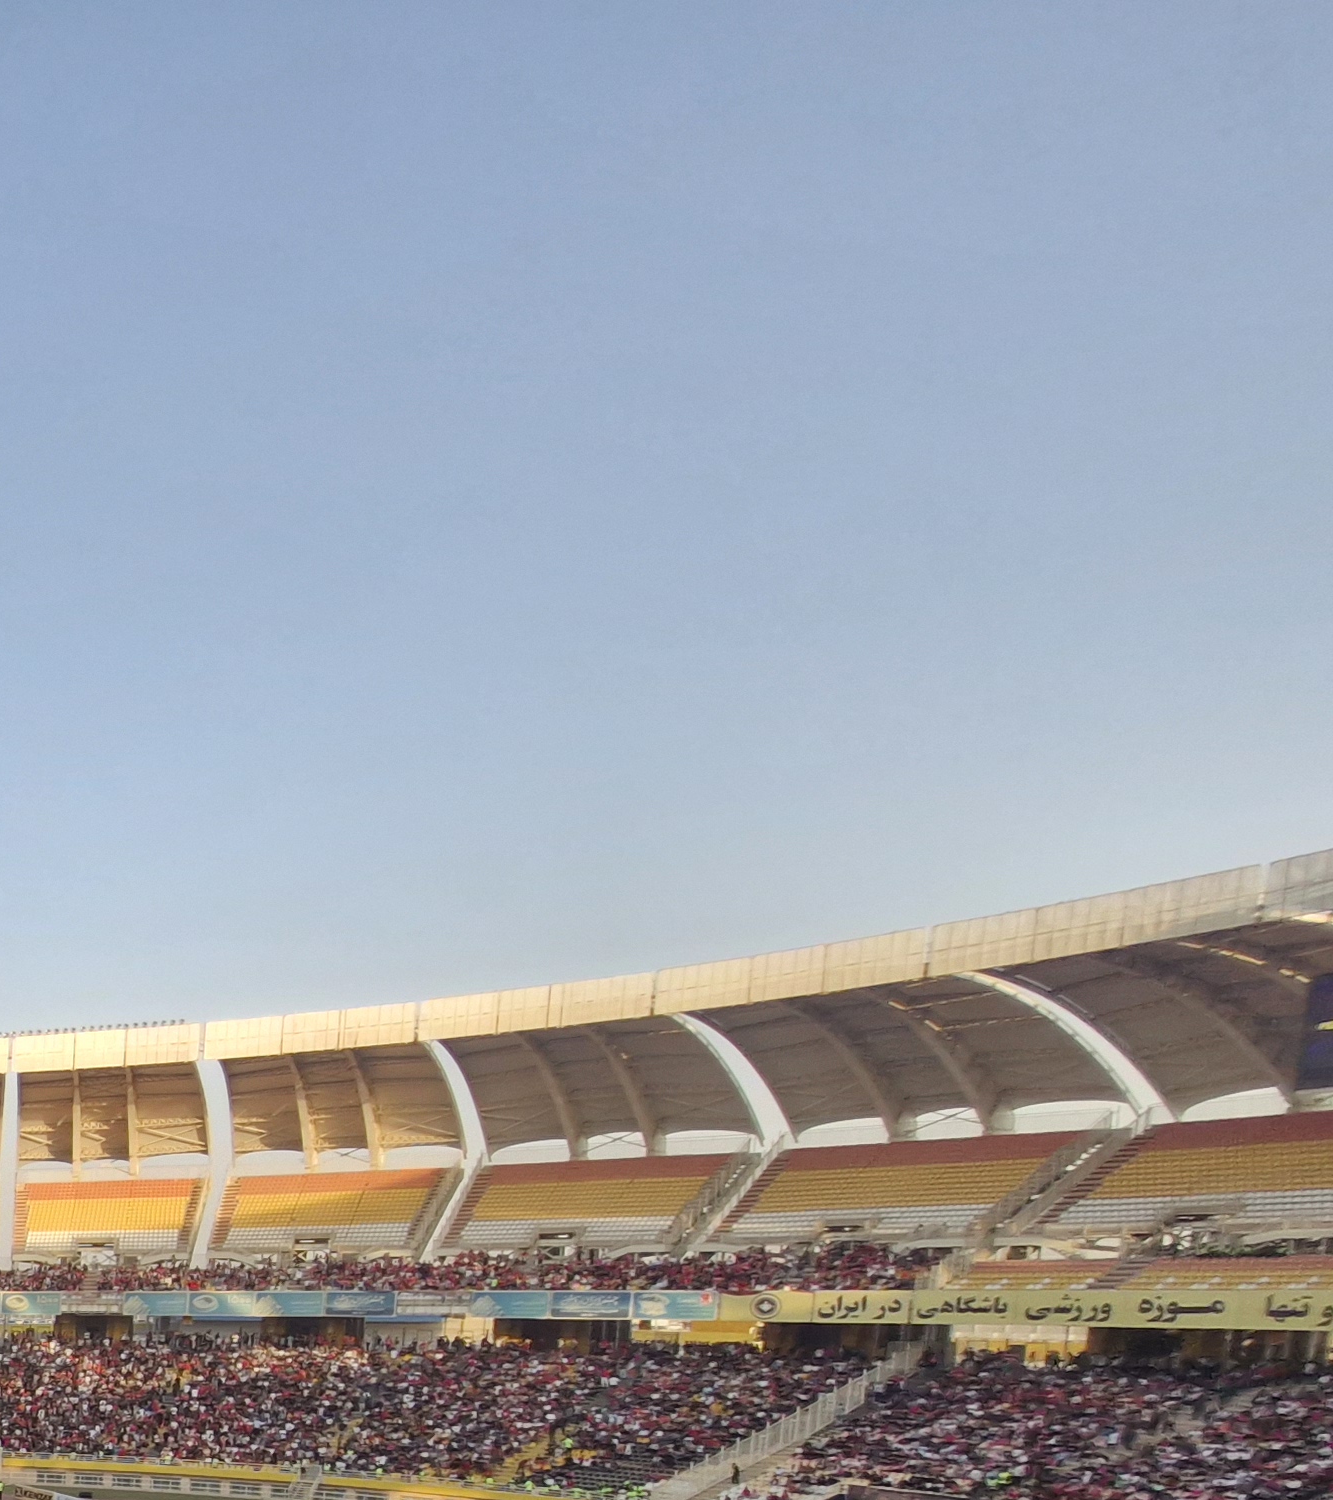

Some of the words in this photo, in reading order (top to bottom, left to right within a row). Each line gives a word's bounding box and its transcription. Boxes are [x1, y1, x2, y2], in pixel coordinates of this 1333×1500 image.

[817, 1296, 868, 1319] ایران
[872, 1299, 902, 1320] در
[917, 1296, 1008, 1319] باشگاهی
[1025, 1294, 1112, 1322] ورزشی
[1137, 1296, 1226, 1323] موزه
[1265, 1294, 1314, 1323] تنها
